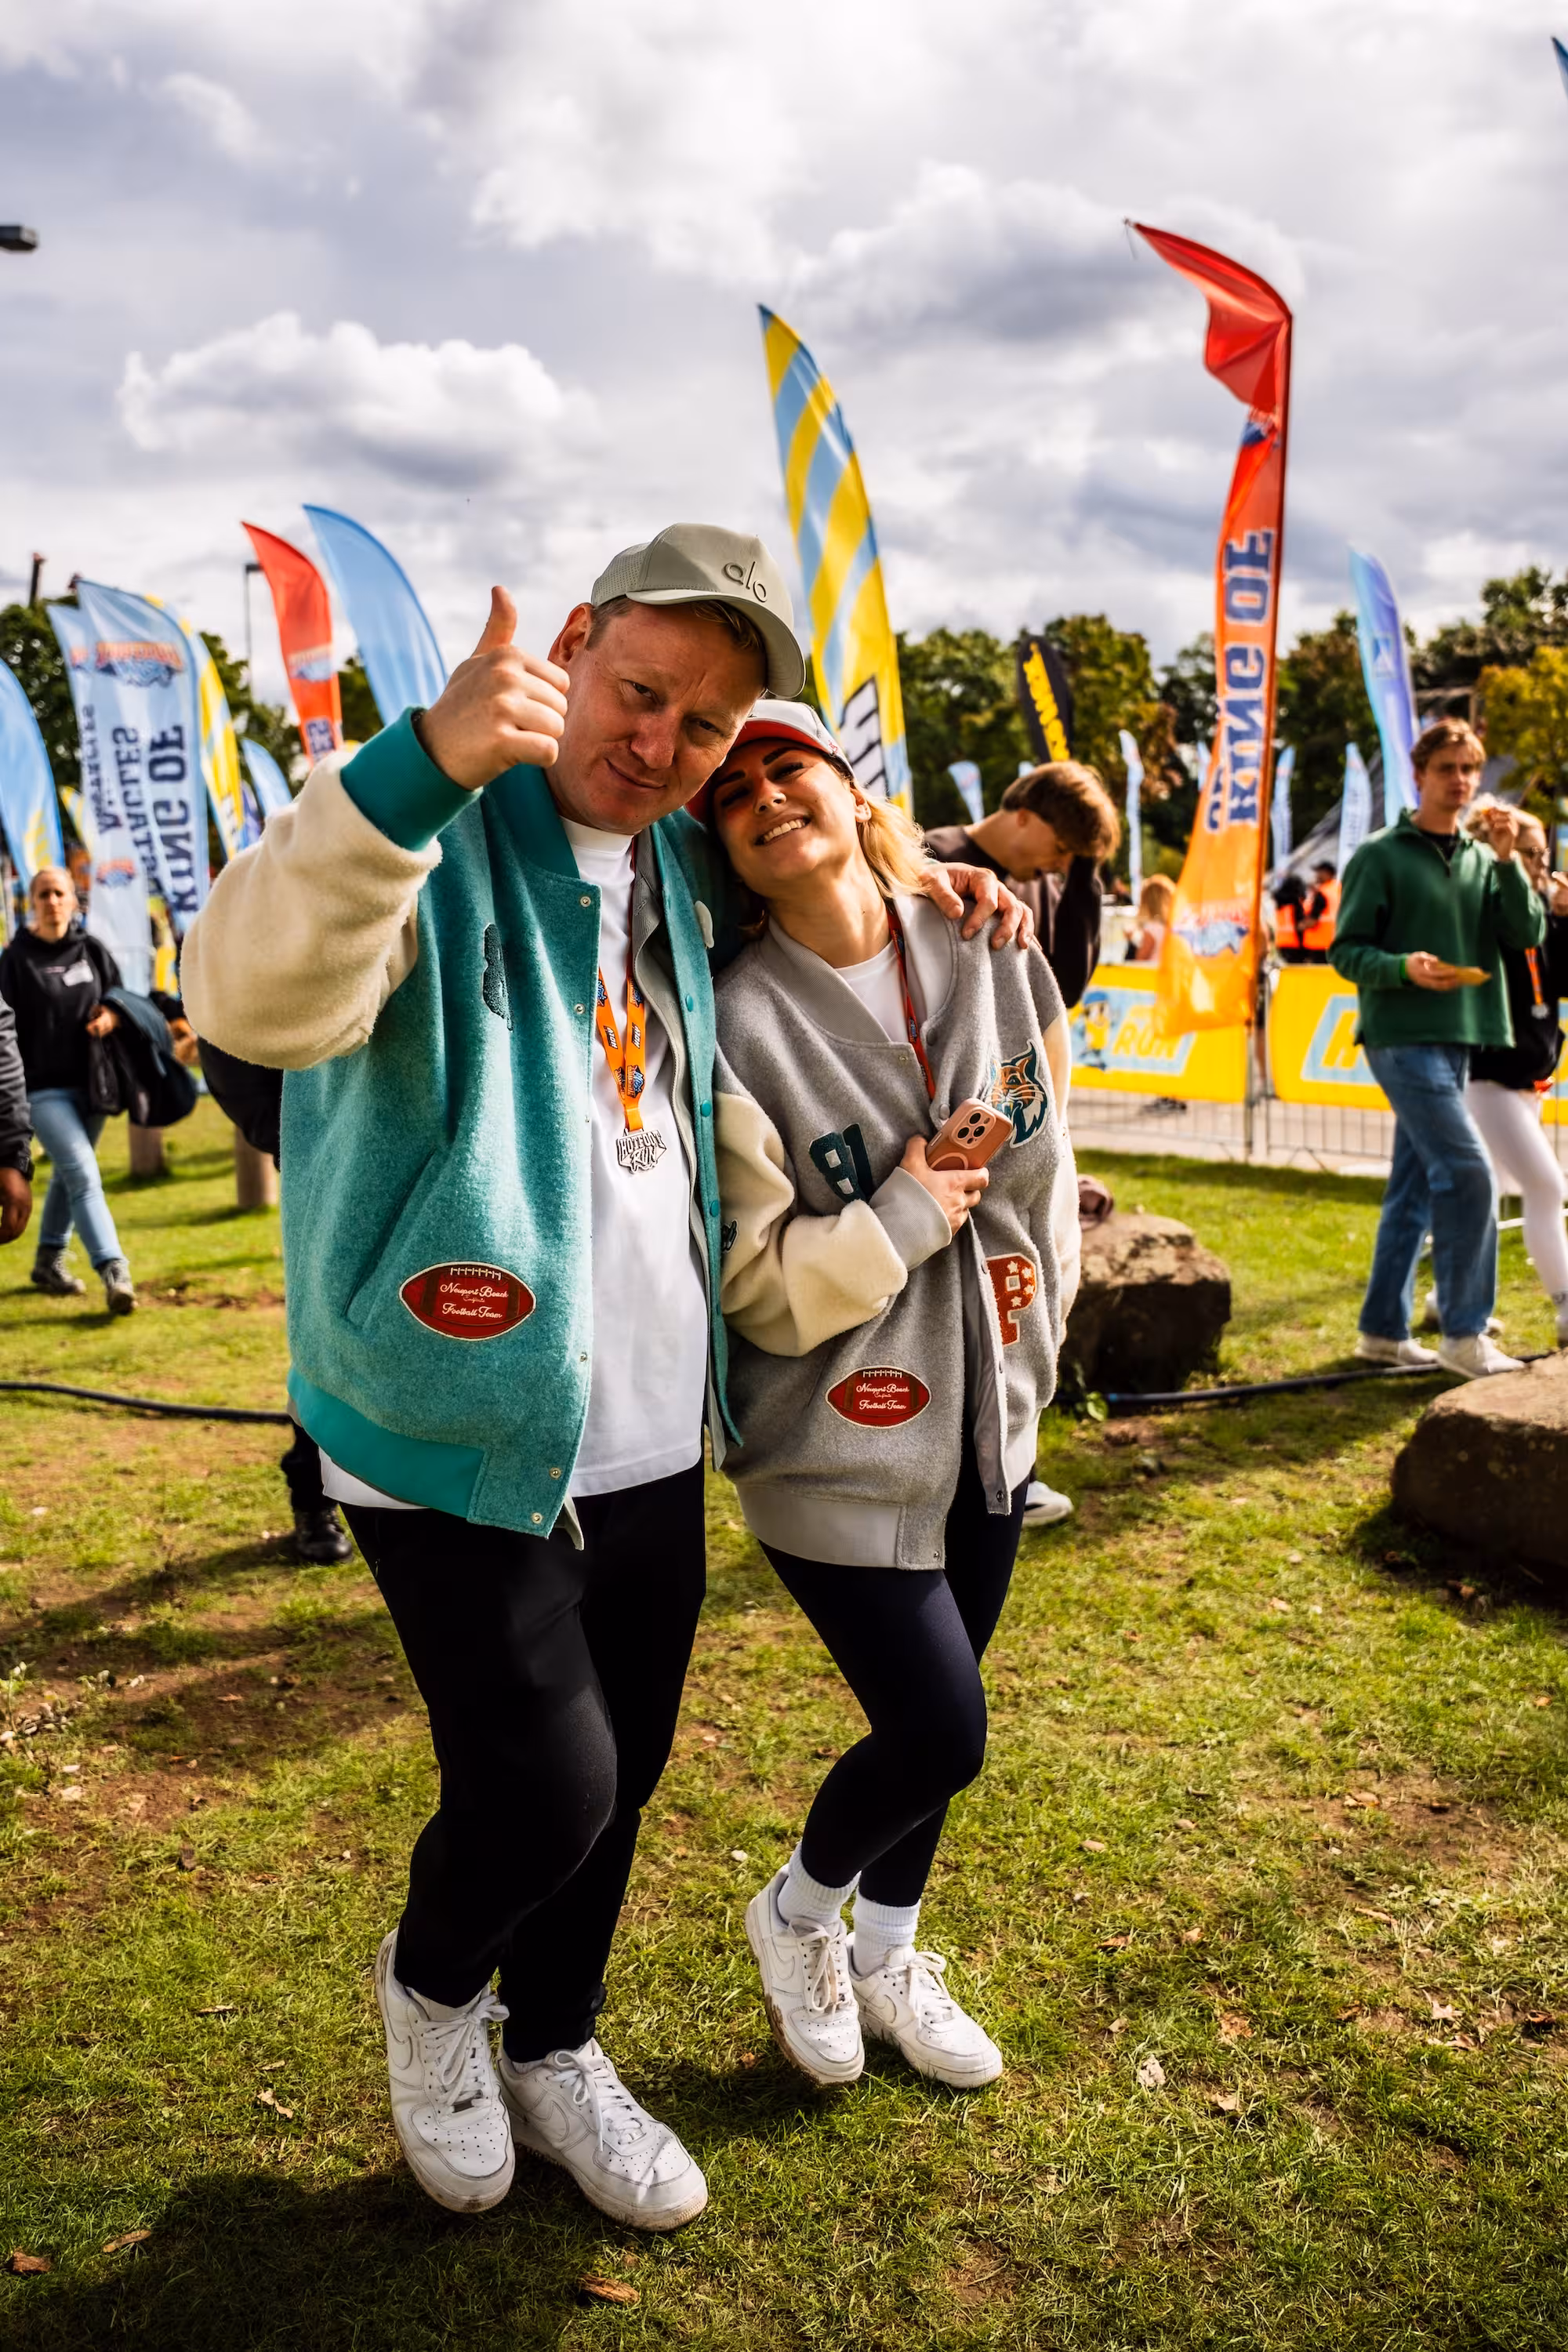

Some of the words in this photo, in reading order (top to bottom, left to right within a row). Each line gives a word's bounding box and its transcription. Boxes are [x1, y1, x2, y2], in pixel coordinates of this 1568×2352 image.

[722, 561, 768, 603] alo
[619, 1130, 666, 1161] HOTFOOT
[630, 1145, 657, 1172] RUN
[440, 1283, 479, 1296] Newport
[479, 1286, 509, 1298] Beach
[985, 1253, 1037, 1347] P
[442, 1302, 477, 1316] Football
[478, 1306, 503, 1318] Team
[856, 1383, 886, 1394] Newport
[887, 1383, 909, 1393] Beach
[859, 1399, 887, 1410] Football
[887, 1399, 906, 1410] Team
